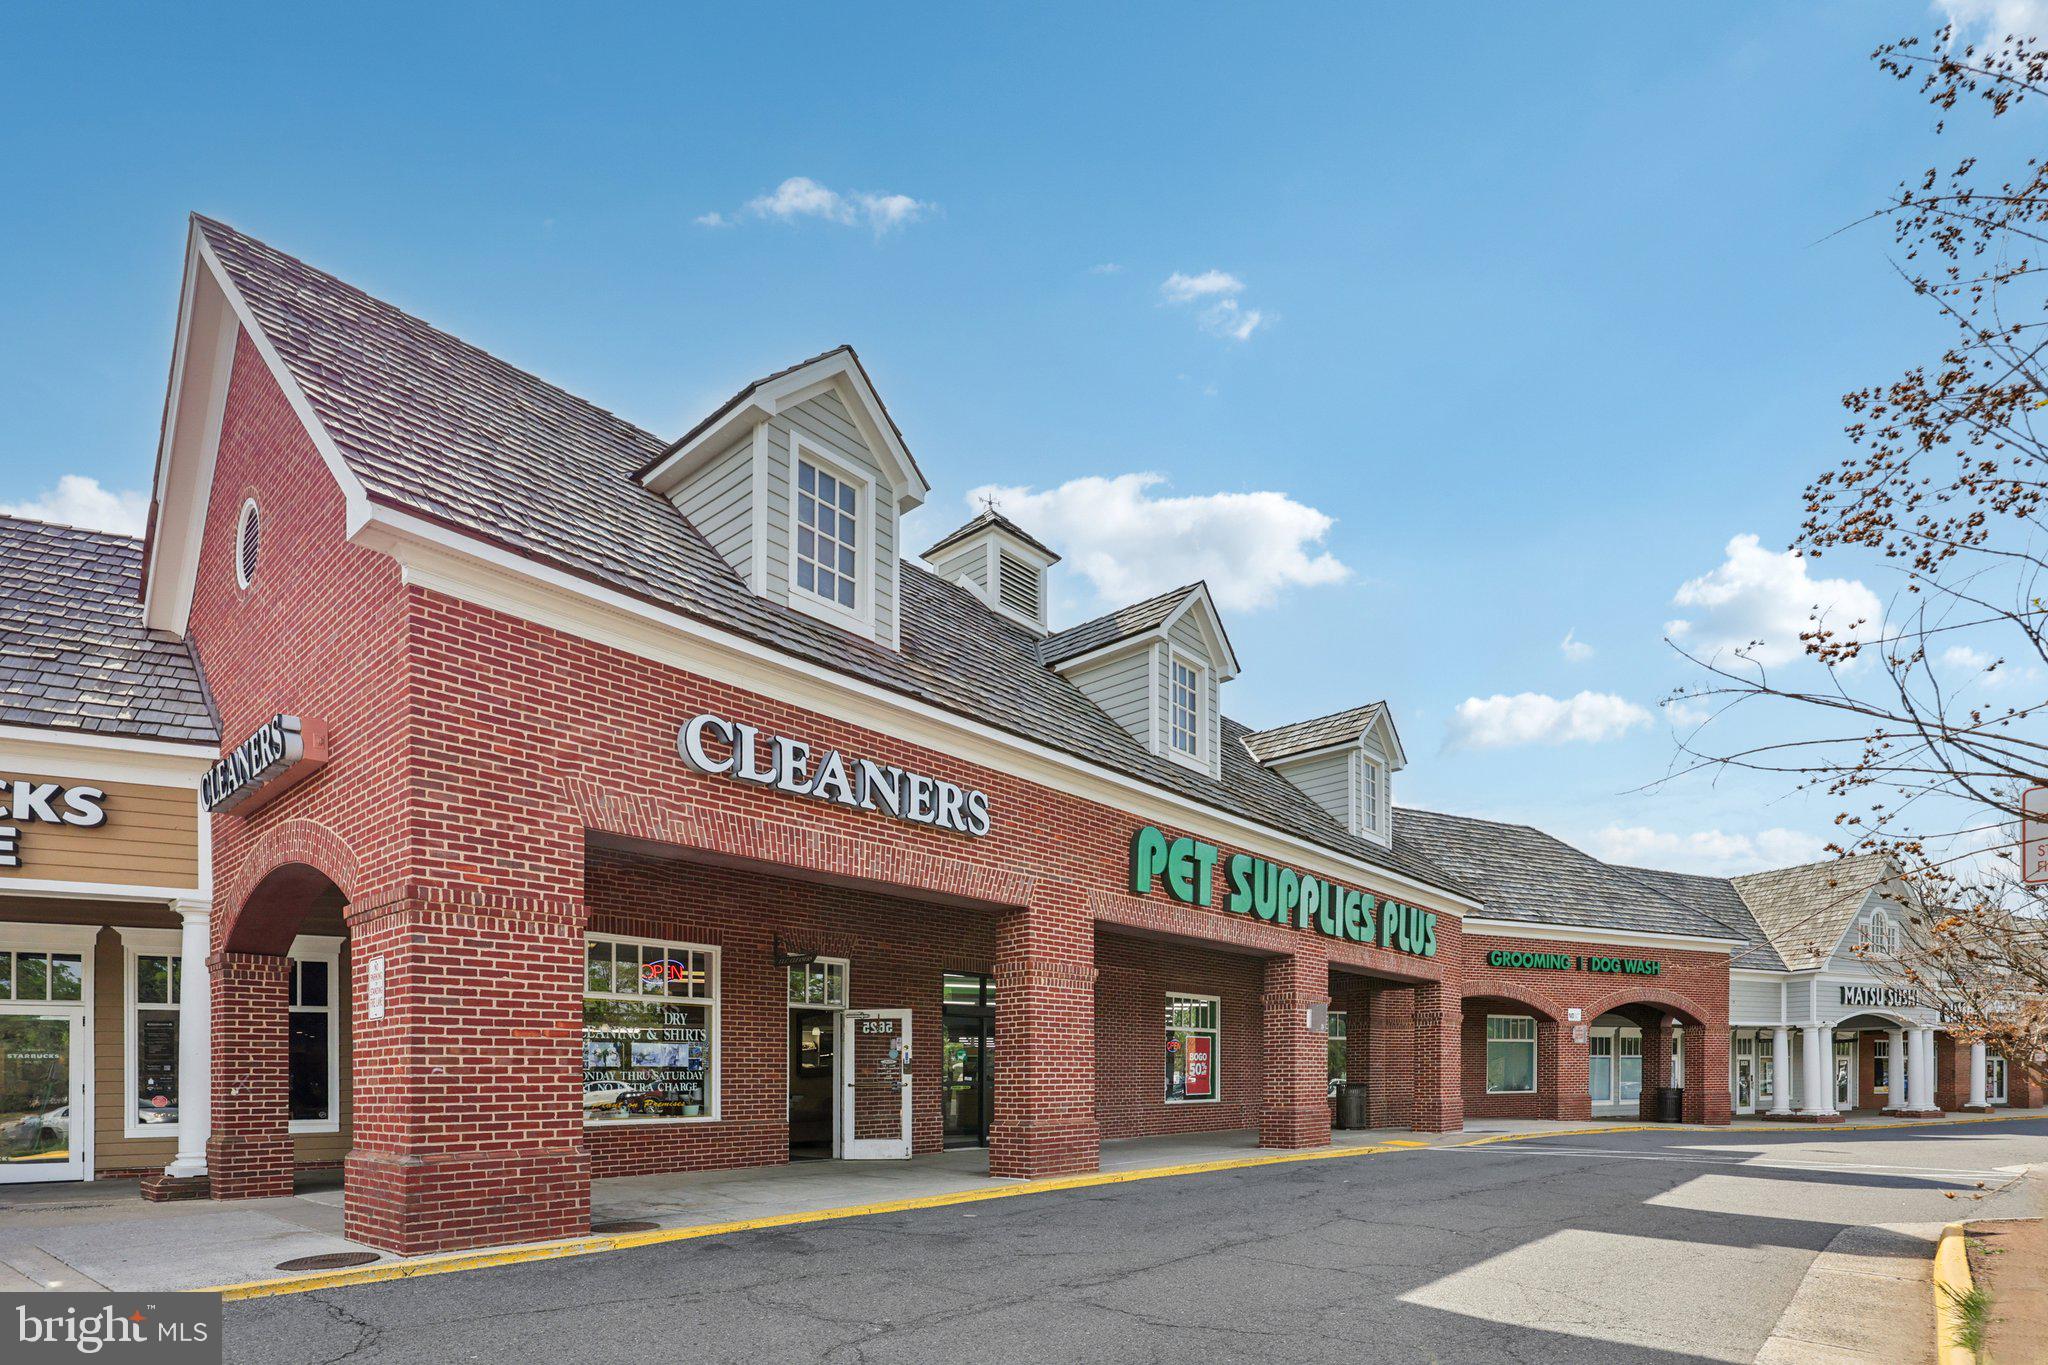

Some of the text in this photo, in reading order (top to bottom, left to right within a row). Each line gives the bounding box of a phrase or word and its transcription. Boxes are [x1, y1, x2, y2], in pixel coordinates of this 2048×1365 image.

[201, 714, 284, 812] CLEANERS
[679, 714, 991, 836] CLEANERS
[0, 780, 104, 826] KS
[1132, 826, 1437, 958] PET SUPPLIES PLUS
[641, 963, 683, 980] OPEN
[1489, 950, 1571, 970] GROOMING
[1590, 957, 1621, 972] DOG
[1624, 959, 1660, 975] WASH
[1843, 986, 1919, 1007] MATSU SUSHI
[664, 1012, 688, 1026] DRY
[646, 1028, 659, 1040] &
[664, 1029, 707, 1041] SHIRTS
[1190, 1053, 1207, 1061] BOGO
[620, 1070, 650, 1081] THRU
[651, 1071, 704, 1081] SATURDAY
[598, 1082, 613, 1091] NO
[617, 1083, 655, 1092] EXTRA
[658, 1083, 698, 1092] CHARGE
